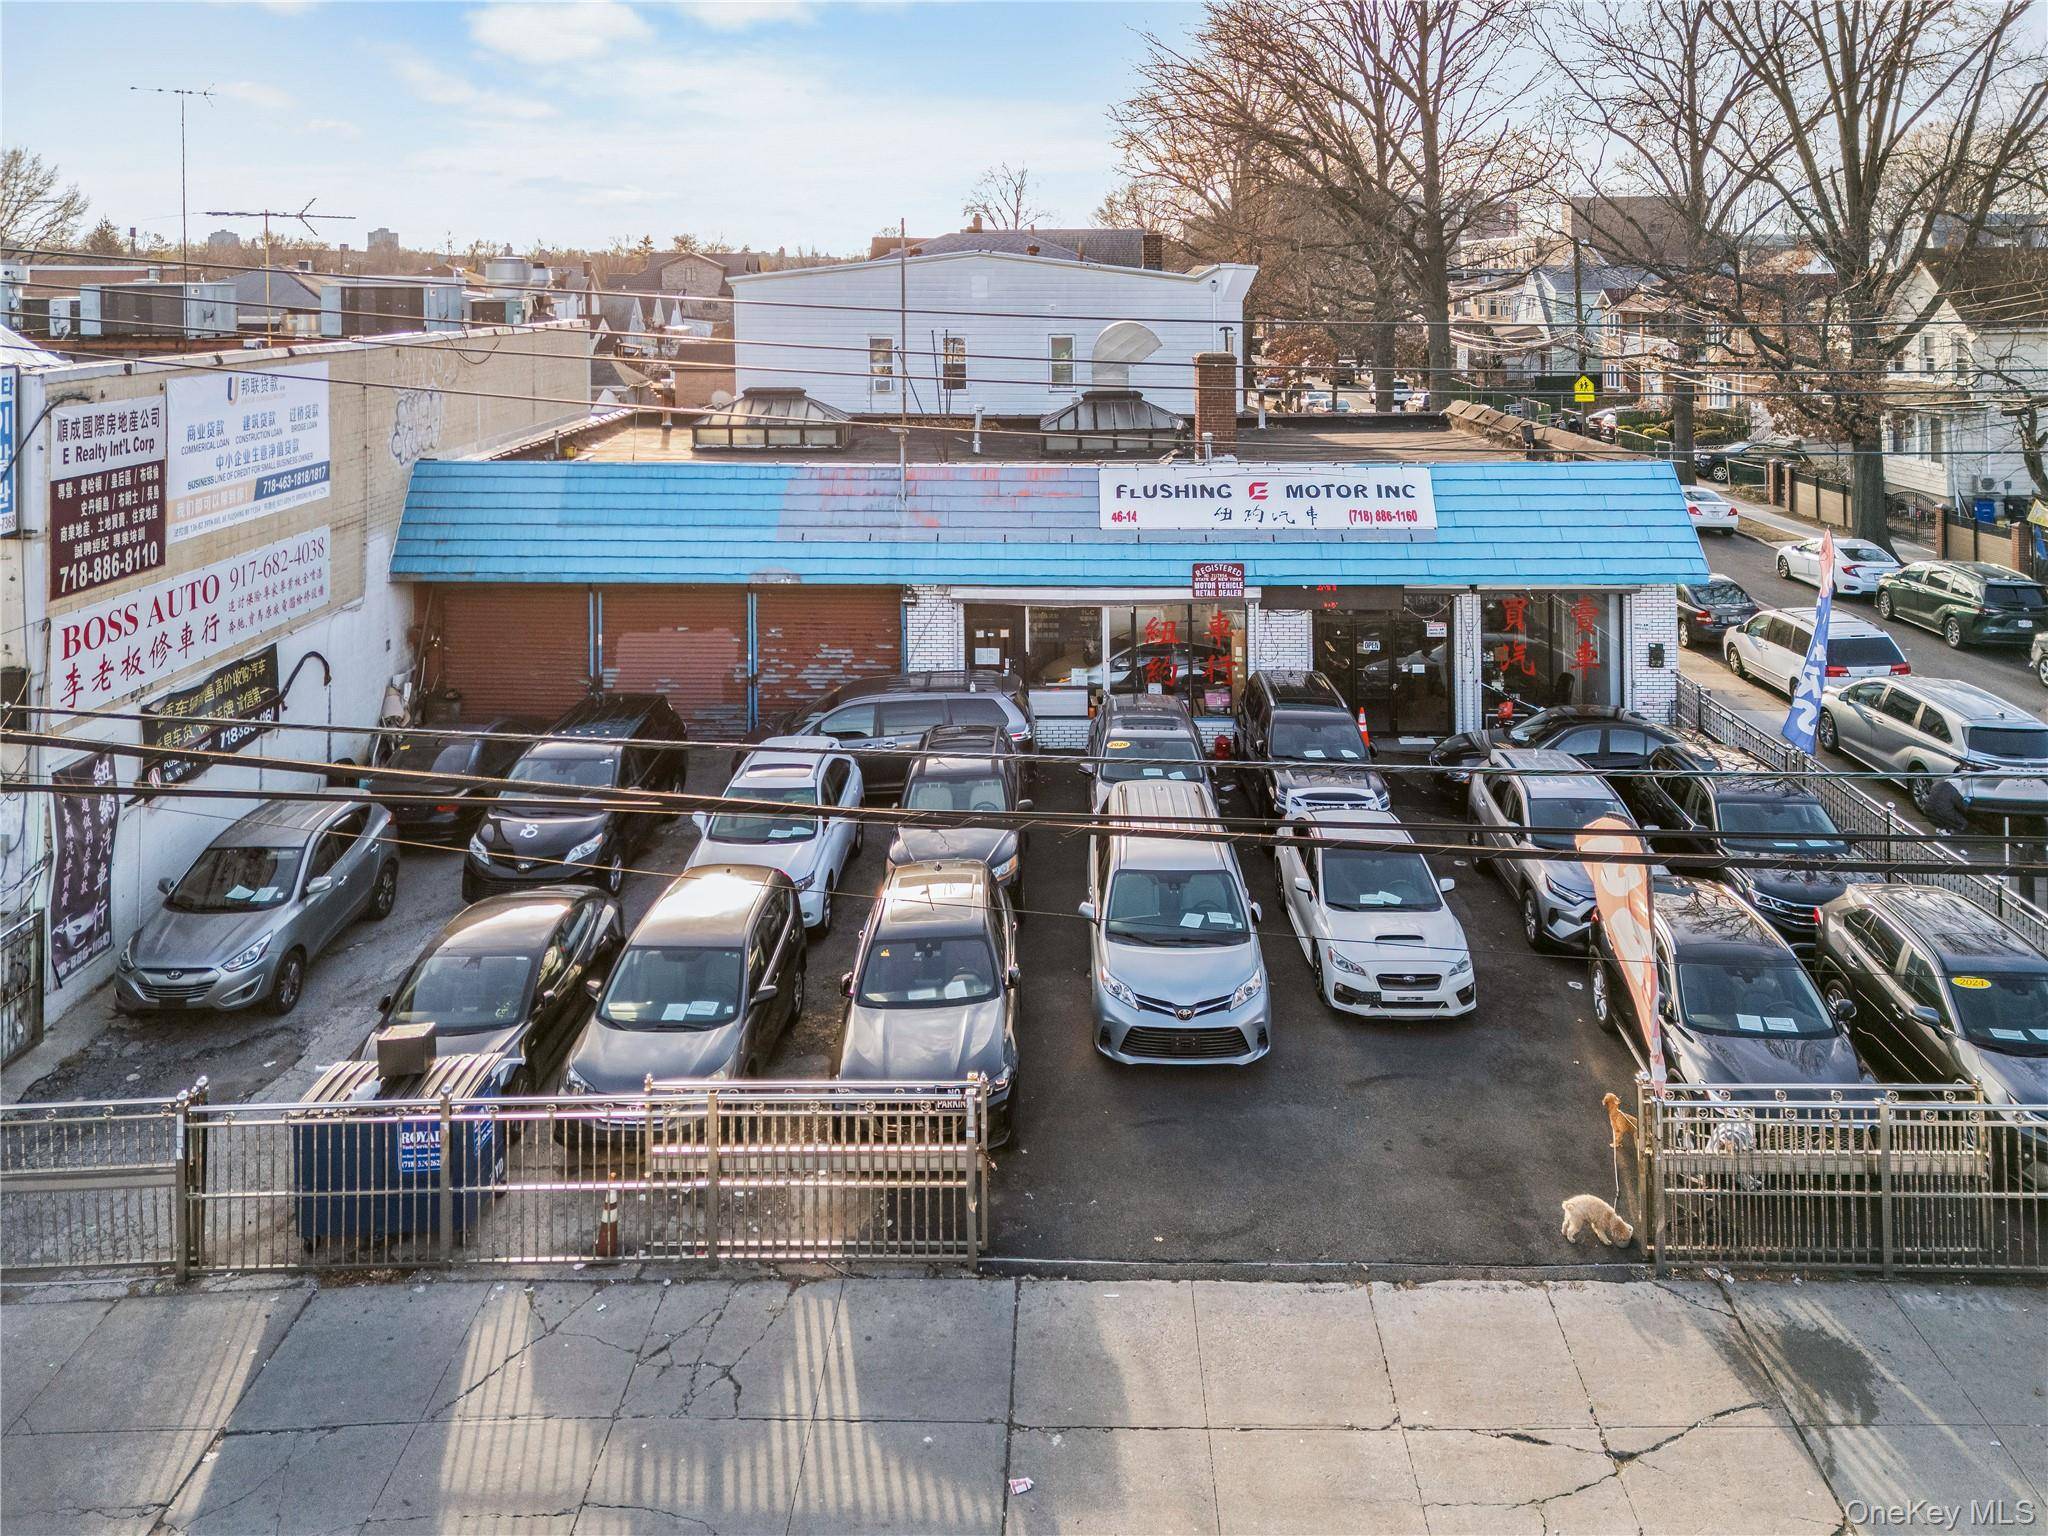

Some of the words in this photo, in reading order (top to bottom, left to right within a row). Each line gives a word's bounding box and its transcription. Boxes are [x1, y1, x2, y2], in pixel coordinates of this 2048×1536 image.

[187, 420, 225, 442] 商业贷款
[235, 432, 271, 445] CONSTRUCTION
[62, 447, 70, 465] E
[76, 444, 108, 463] Realty
[133, 437, 155, 455] Corp
[188, 475, 214, 490] BUSINESS
[1116, 483, 1232, 499] FLUSHING
[1286, 483, 1368, 499] MOTOR
[1377, 483, 1416, 499] INC
[1111, 510, 1137, 523] 46-14
[1348, 508, 1373, 525] (718)
[1375, 509, 1418, 523] 886-1160
[59, 540, 158, 593] 718-886-8110
[229, 536, 325, 592] 917-682-4038
[1195, 564, 1242, 577] REGISTERED
[1194, 581, 1216, 589] MOTOR
[1217, 581, 1244, 589] VEHICLE
[1195, 589, 1217, 597] RETAIL
[1218, 589, 1242, 597] DEALER
[61, 602, 139, 661] BOSS
[147, 574, 220, 628] AUTO
[1364, 641, 1379, 650] OPEN
[1959, 979, 1984, 987] 2024
[937, 1100, 967, 1109] PARKIN
